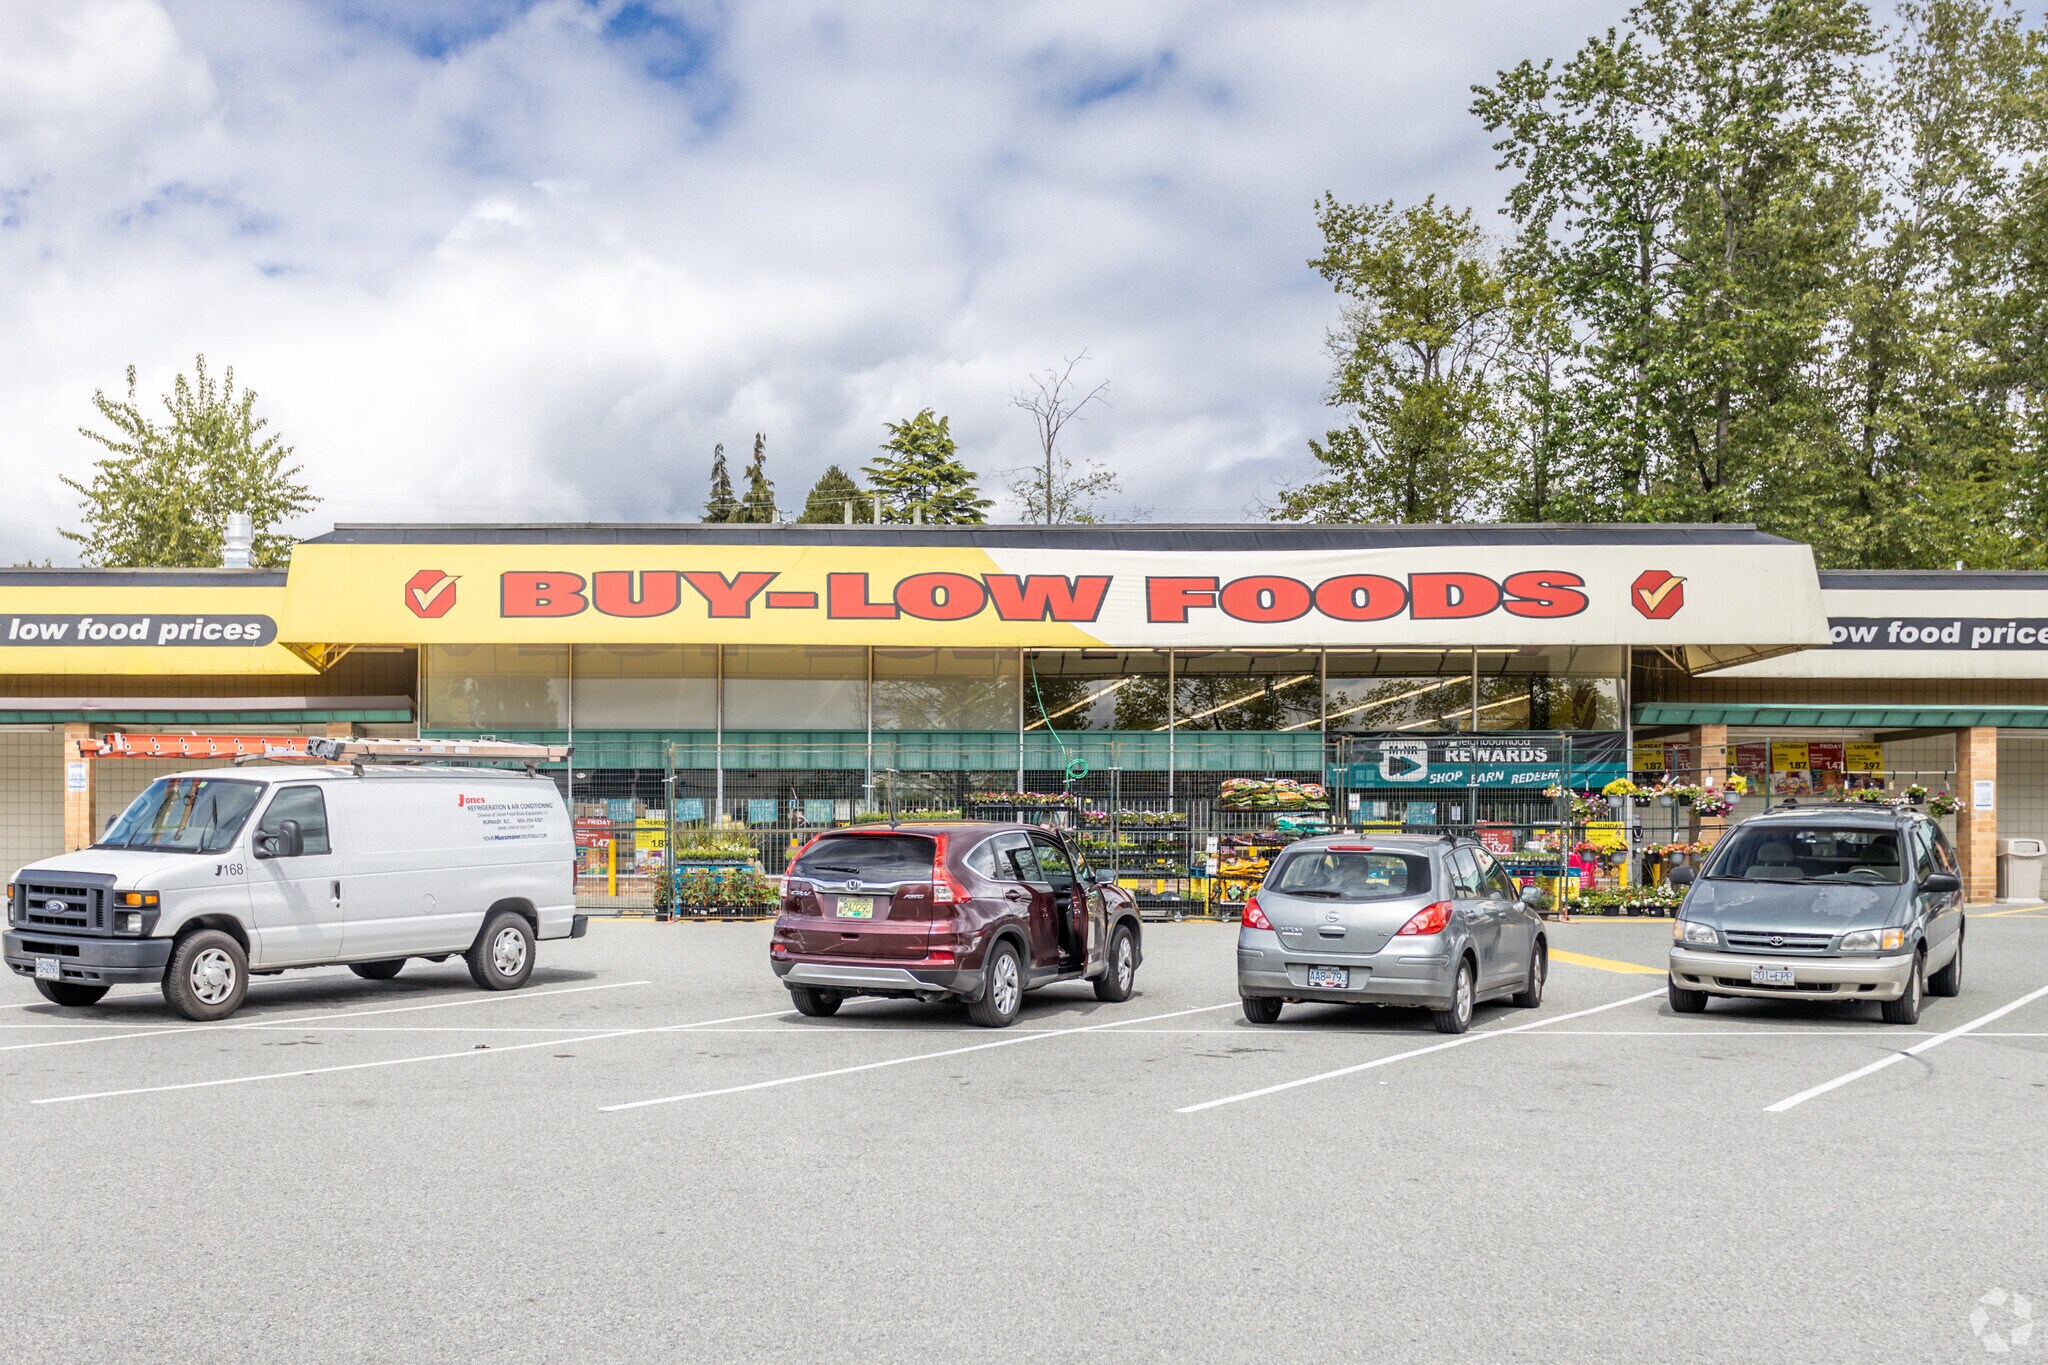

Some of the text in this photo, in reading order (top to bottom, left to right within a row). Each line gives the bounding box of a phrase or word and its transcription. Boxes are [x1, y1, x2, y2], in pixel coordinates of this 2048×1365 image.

[500, 570, 1590, 624] BUY-LOW FOODS
[8, 618, 262, 645] low food prices
[1830, 621, 2048, 649] ow food price
[1445, 747, 1548, 763] REWARDS
[1429, 770, 1463, 784] SHOP
[1471, 770, 1505, 784] EARN
[1511, 770, 1560, 785] REDEEM
[458, 793, 485, 807] Jones
[467, 804, 506, 812] REFRIGERATION
[215, 863, 244, 876] J168
